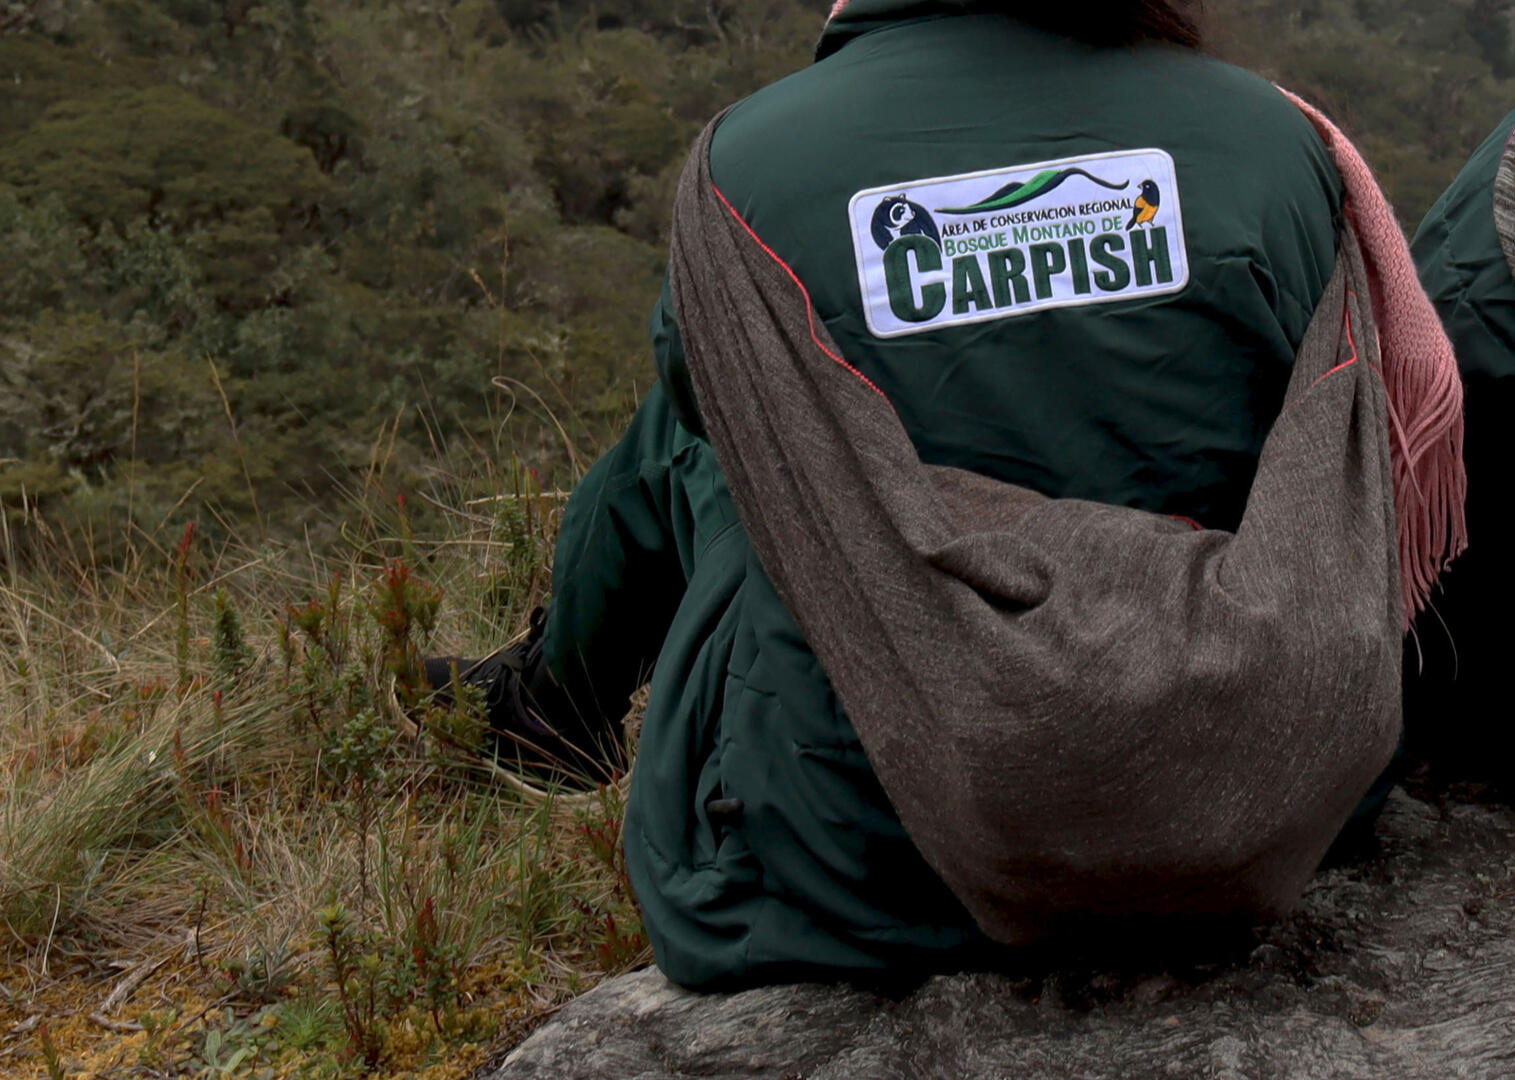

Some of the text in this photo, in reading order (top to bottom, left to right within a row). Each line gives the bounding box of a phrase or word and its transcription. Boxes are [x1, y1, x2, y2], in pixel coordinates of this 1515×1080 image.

[972, 218, 987, 233] DE
[990, 206, 1076, 228] CONSERVACION
[1078, 198, 1133, 215] REGIONAL
[1101, 216, 1122, 232] DE
[882, 225, 1173, 323] CARPISH
